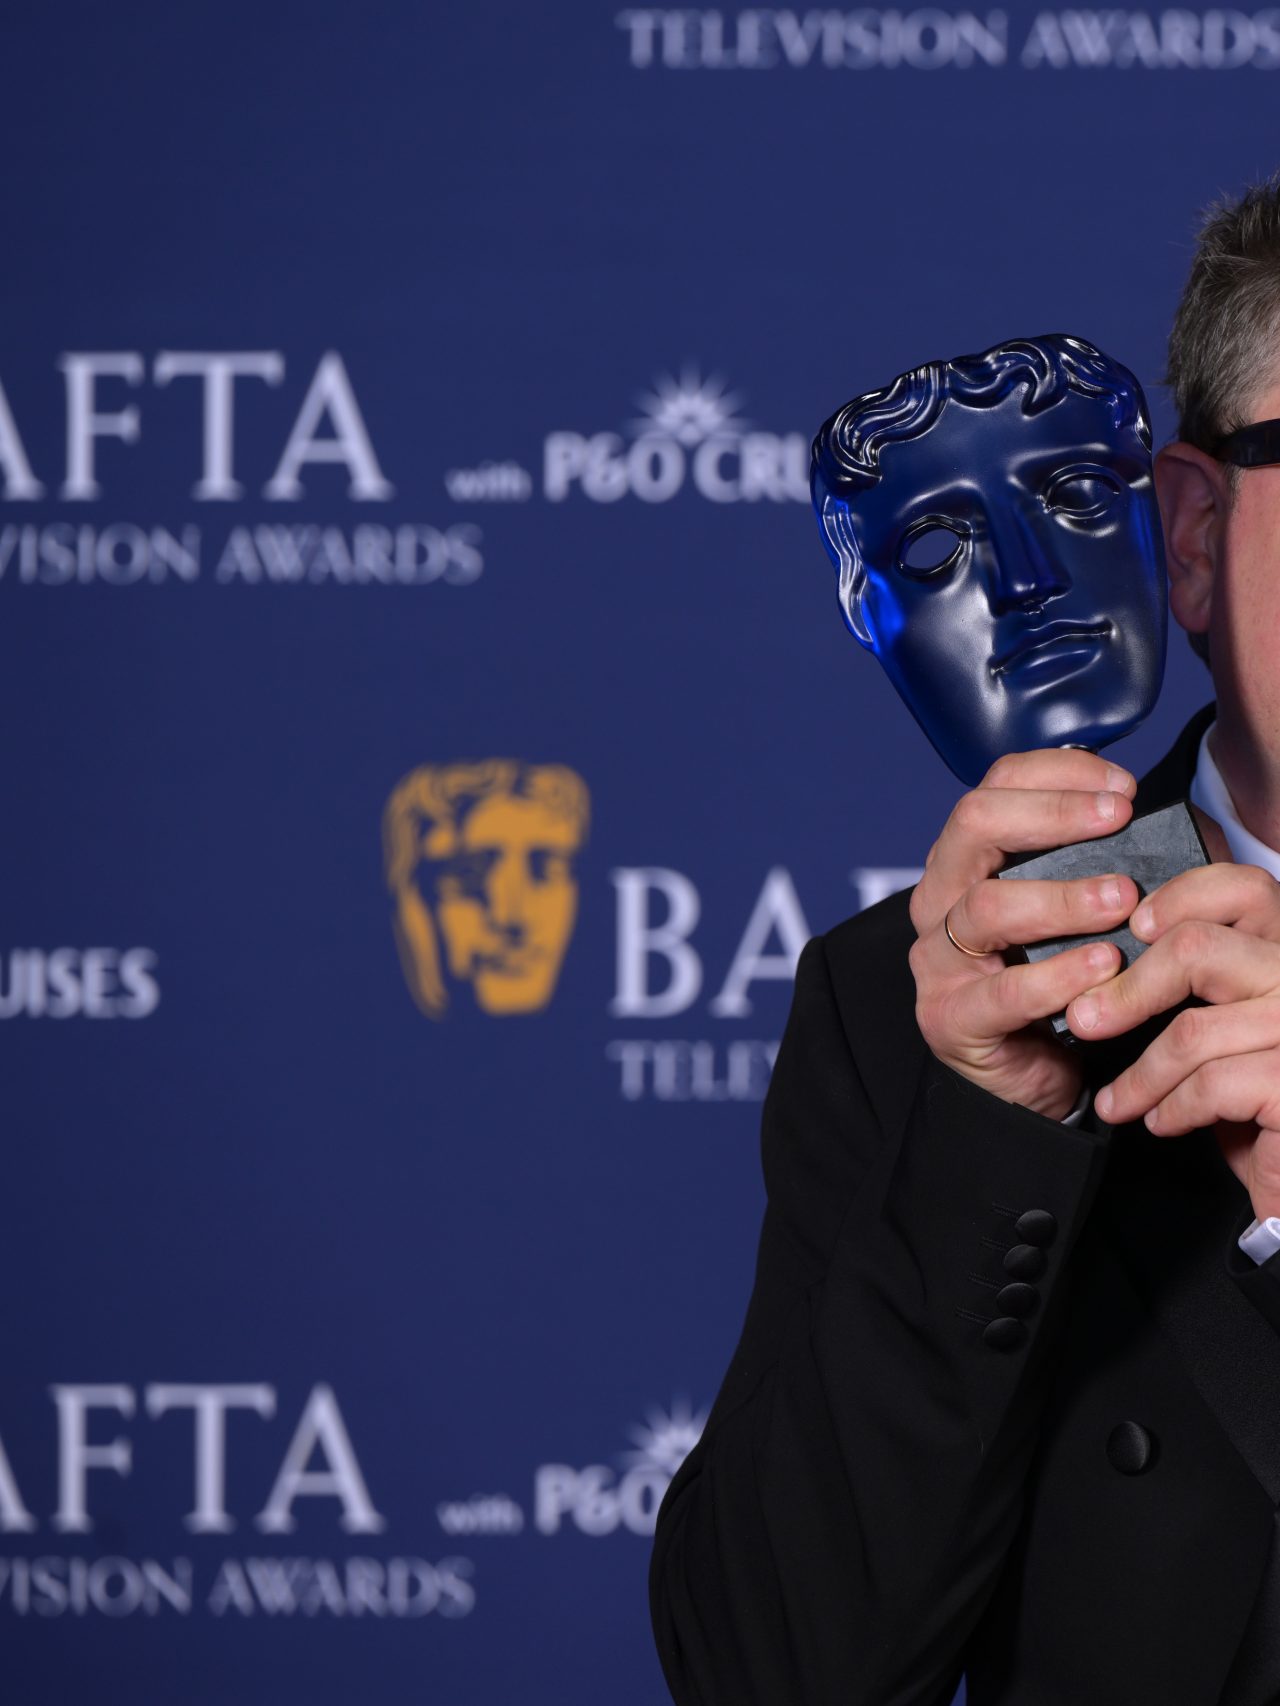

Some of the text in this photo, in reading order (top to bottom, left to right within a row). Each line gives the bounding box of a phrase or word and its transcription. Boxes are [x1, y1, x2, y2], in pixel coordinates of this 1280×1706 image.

[619, 10, 1007, 68] TELEVISION
[445, 462, 532, 501] with
[544, 432, 686, 502] P&O
[217, 524, 483, 584] AWARDS
[437, 1495, 524, 1534] with
[0, 1557, 475, 1616] ISION AWARDS
